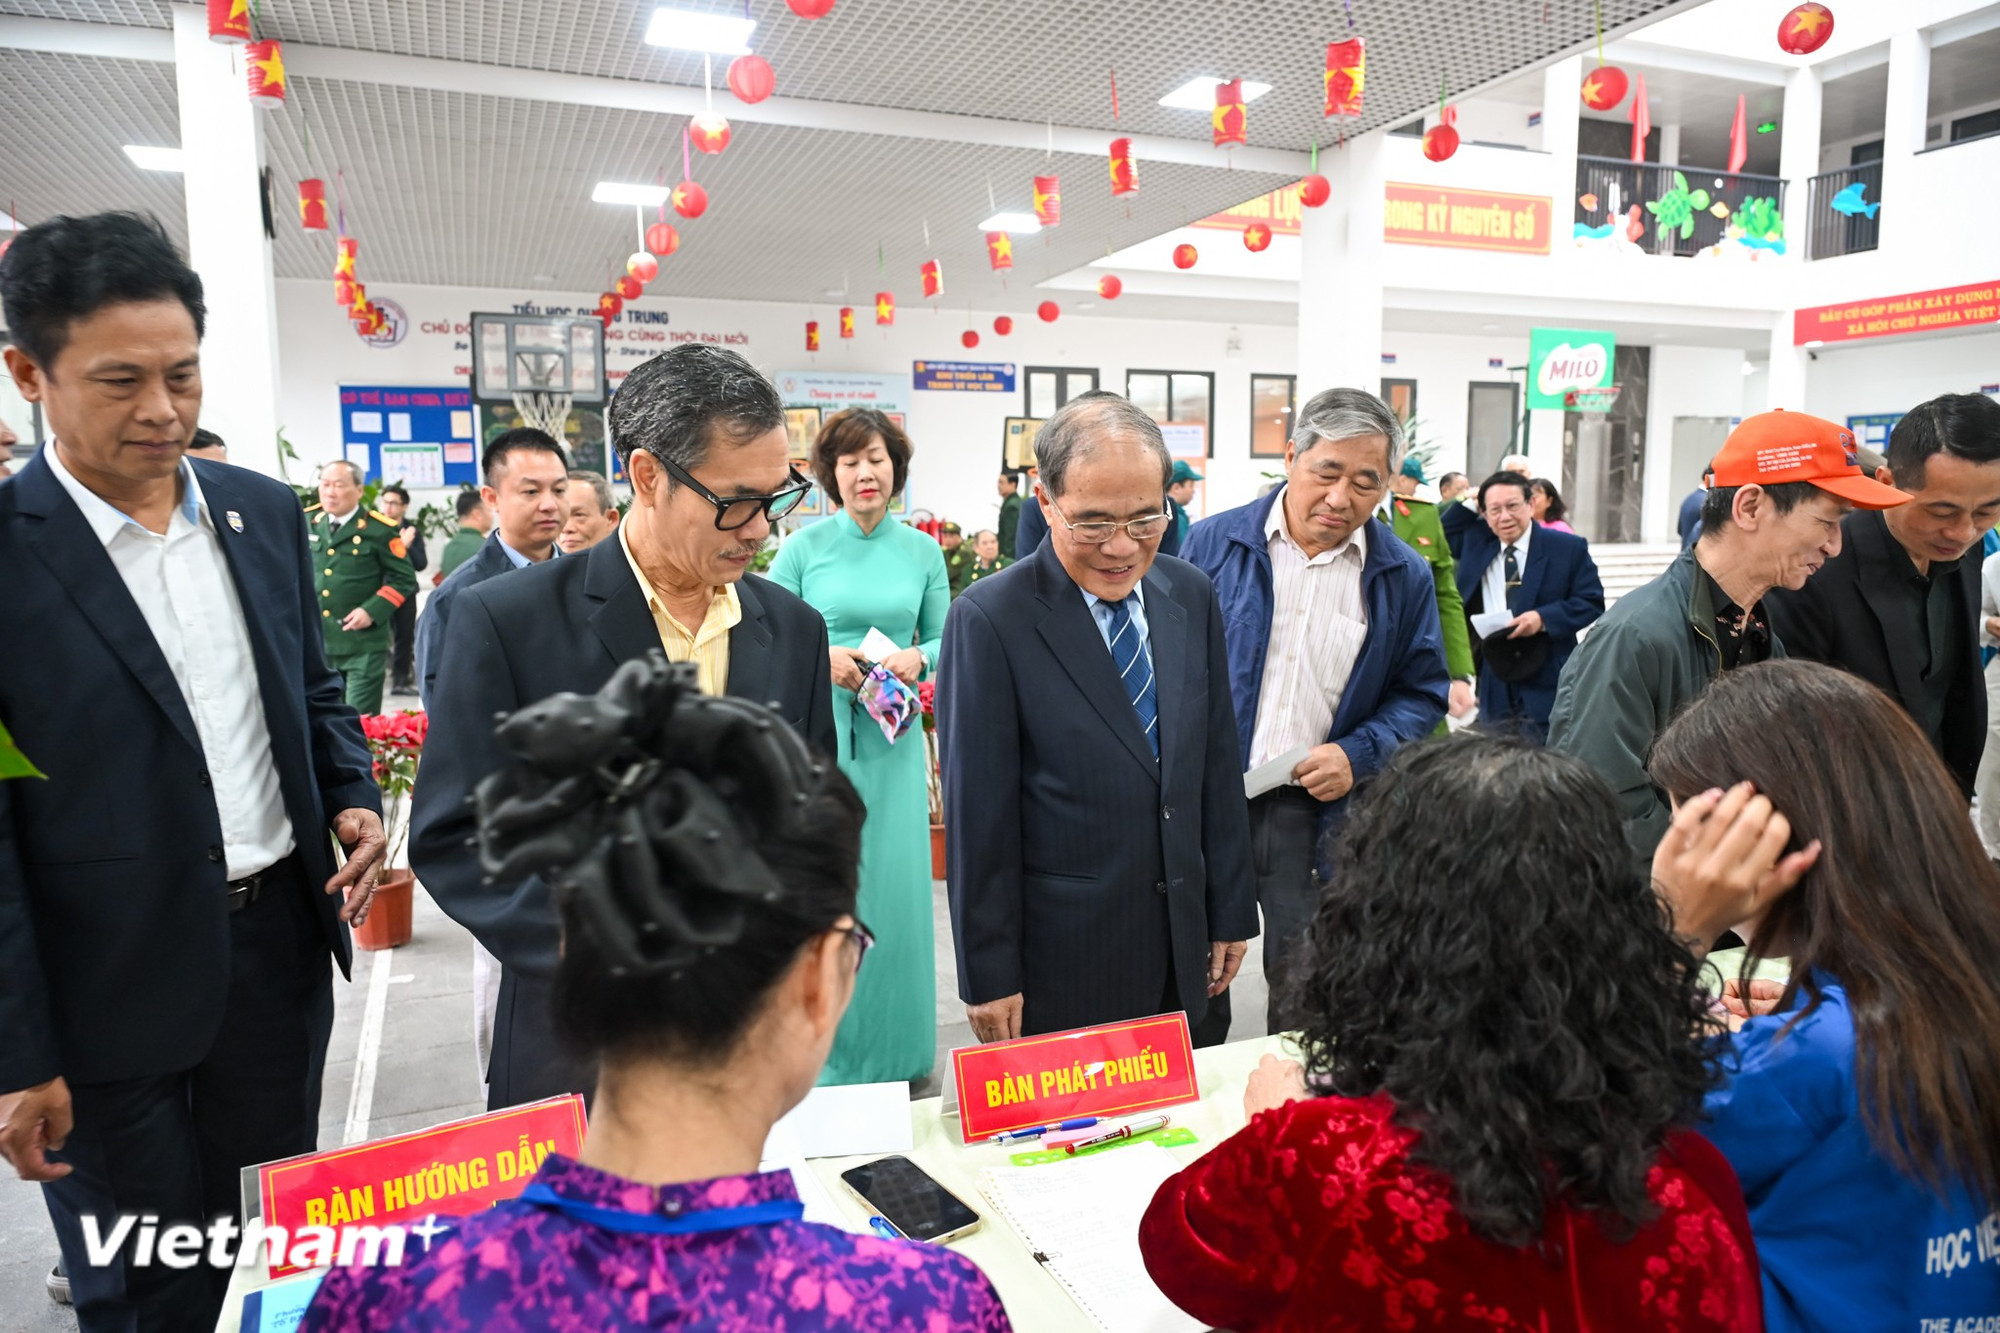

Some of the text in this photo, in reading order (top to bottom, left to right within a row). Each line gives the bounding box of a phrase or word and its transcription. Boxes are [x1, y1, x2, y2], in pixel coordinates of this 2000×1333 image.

[1385, 199, 1424, 231] RONG
[1450, 203, 1512, 239] NGUYÊN
[1513, 202, 1536, 241] SỐ
[627, 310, 669, 325] TRUNG
[1549, 359, 1599, 381] MILO
[985, 1044, 1169, 1109] BÀN PHÁT PHIẾU
[305, 1133, 556, 1228] BÀN HƯỚNG DẪN
[1926, 1227, 1971, 1279] HỌC
[1920, 1317, 1950, 1333] THE
